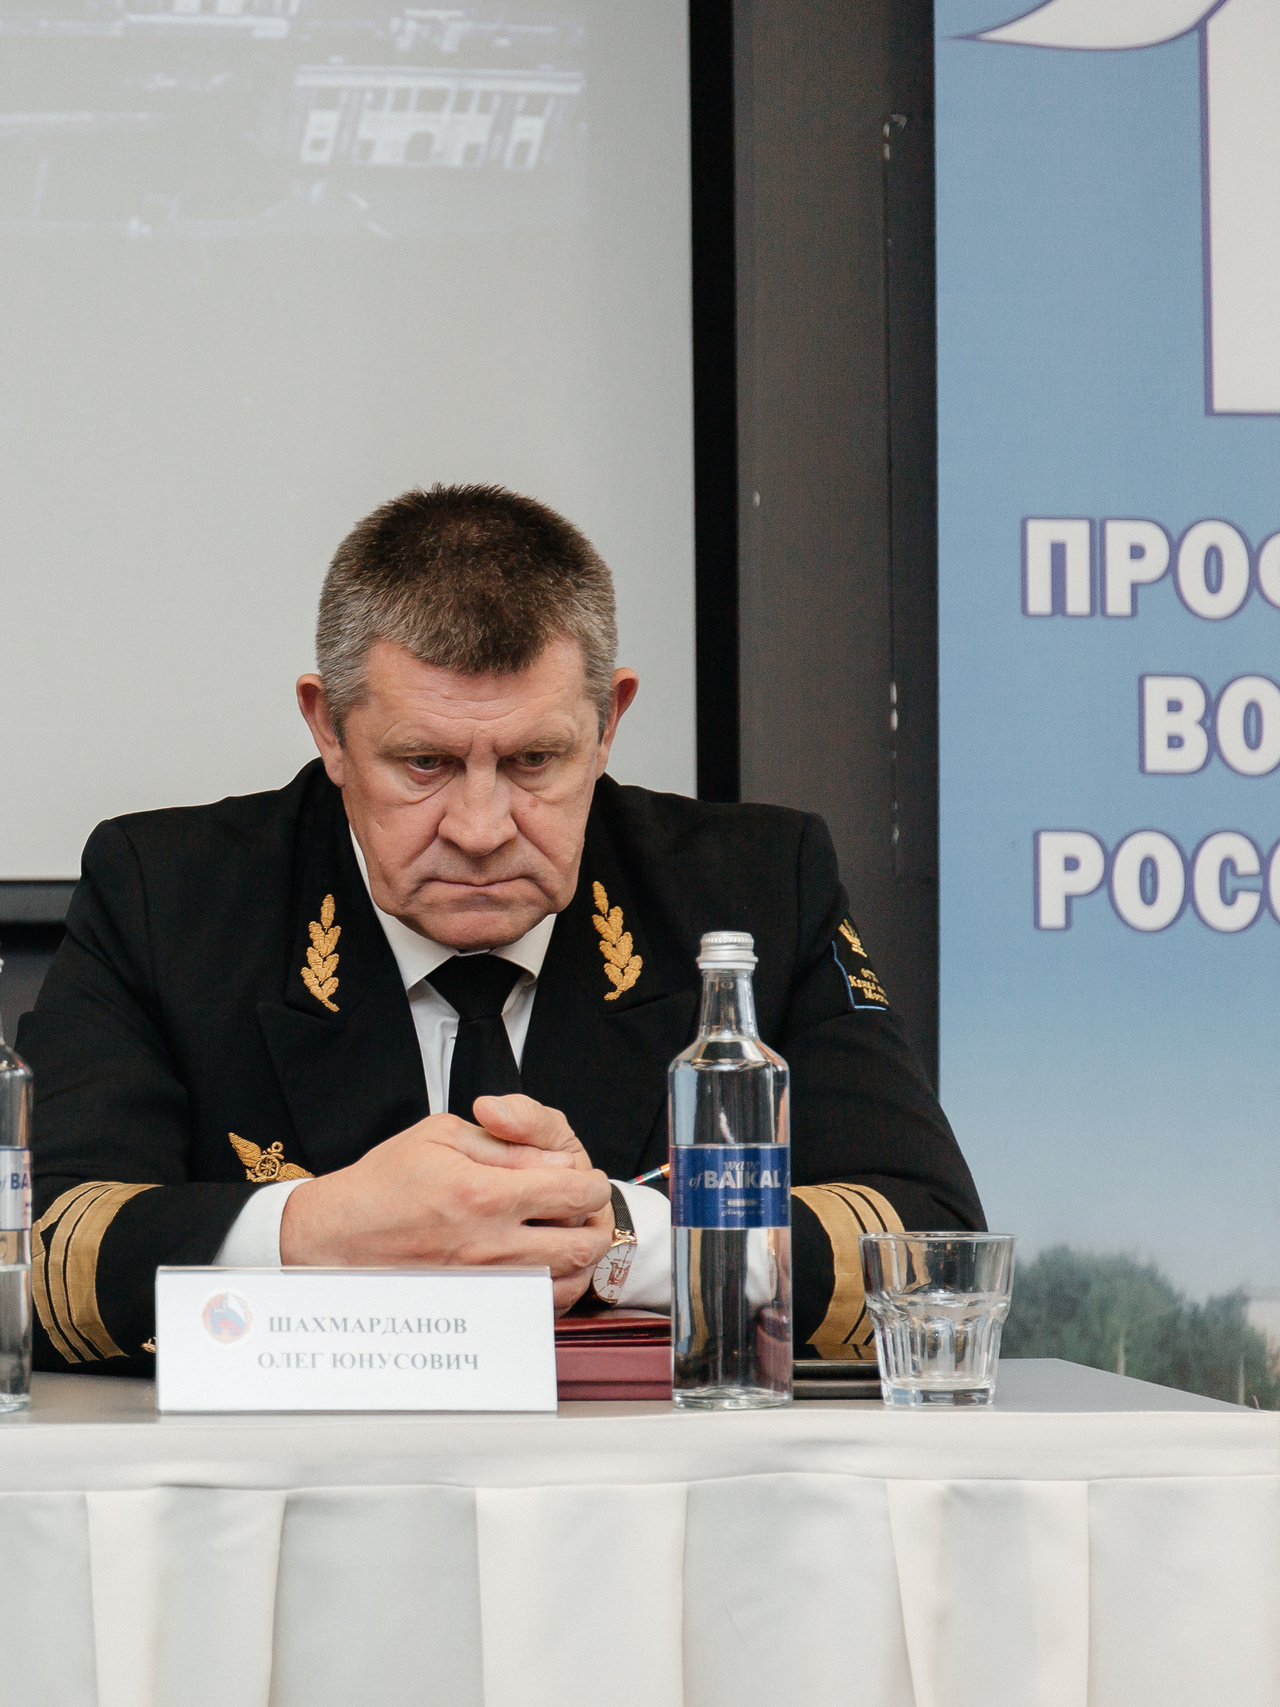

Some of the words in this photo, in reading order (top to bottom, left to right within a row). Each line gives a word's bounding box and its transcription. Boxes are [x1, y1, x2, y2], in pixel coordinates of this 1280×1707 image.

[1022, 517, 1280, 621] ПРО
[1034, 829, 1280, 933] РОС
[704, 1170, 781, 1189] BAIKAL
[268, 1316, 468, 1336] ШАХМАРДАНОВ
[257, 1352, 325, 1370] ОЛЕГ
[331, 1352, 480, 1371] ЮНУСОВИЧ
